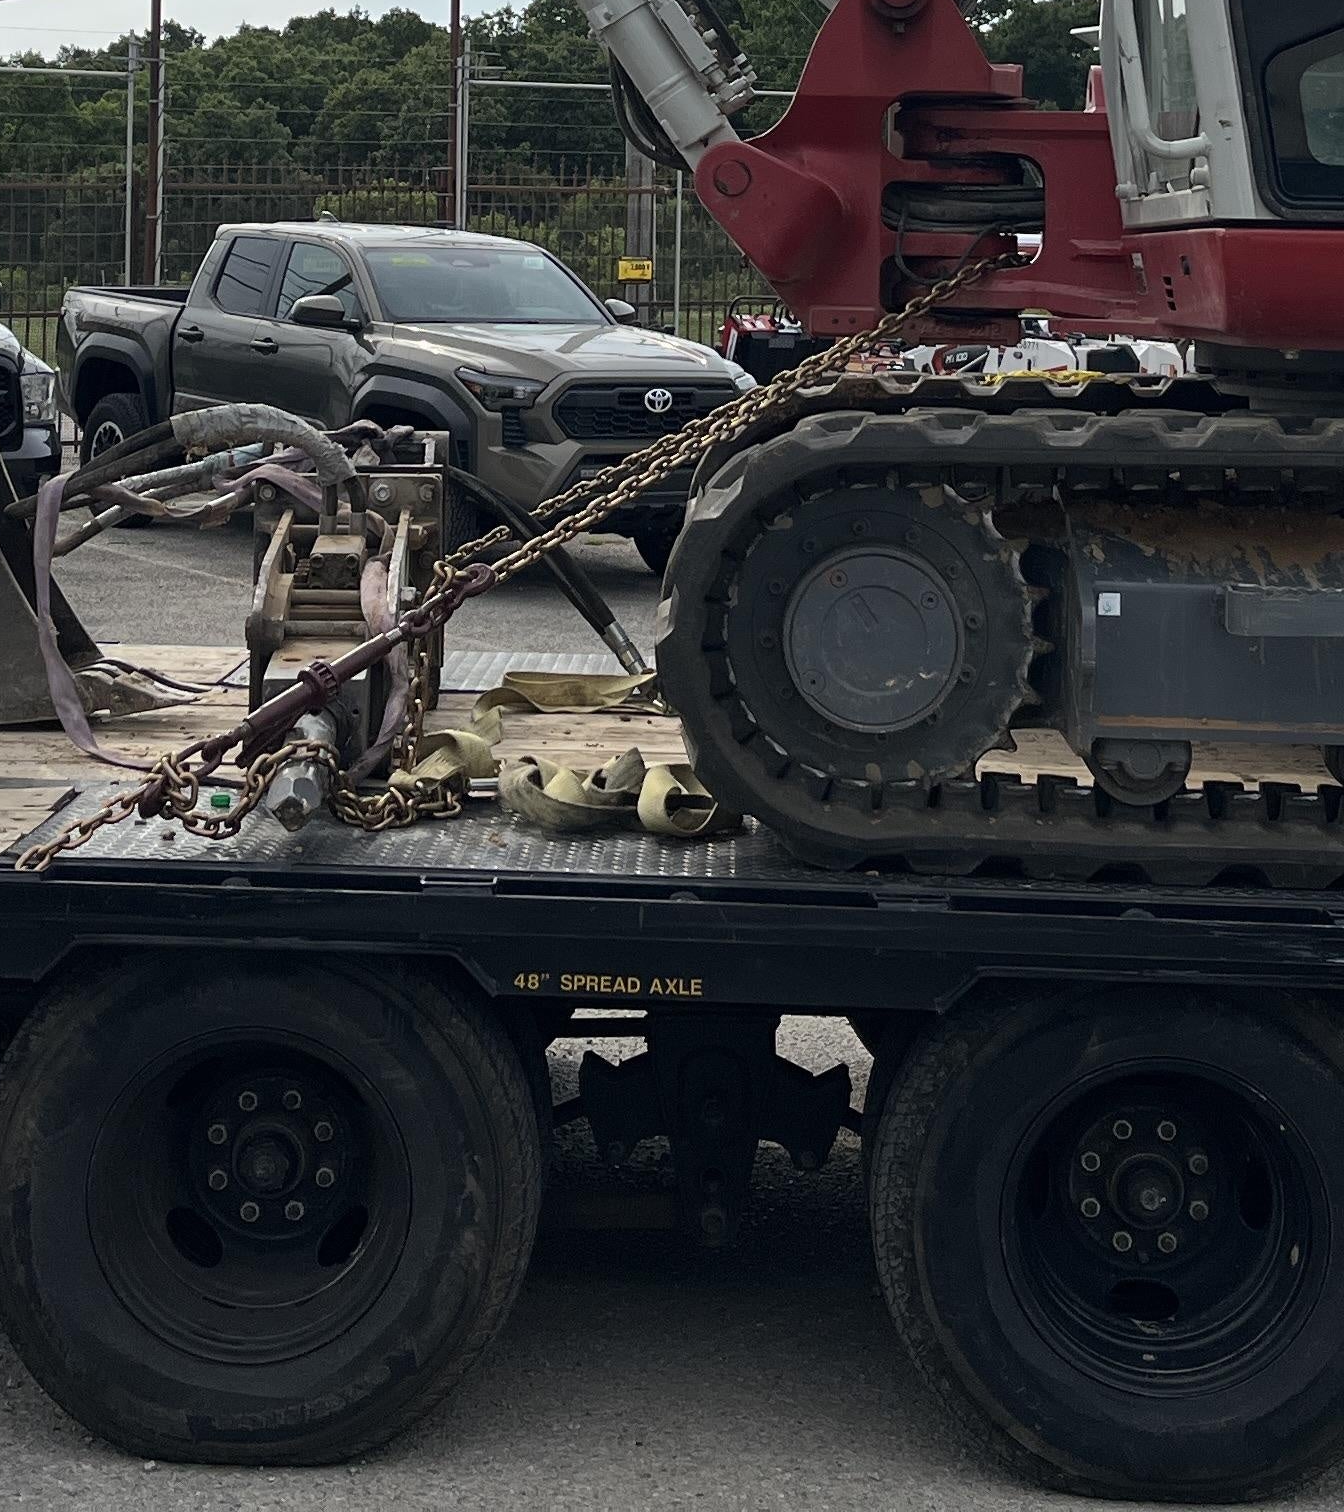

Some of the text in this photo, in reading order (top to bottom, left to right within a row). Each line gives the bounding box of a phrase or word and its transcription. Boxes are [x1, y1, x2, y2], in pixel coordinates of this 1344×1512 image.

[513, 972, 703, 996] 48" SPREAD AXLE
